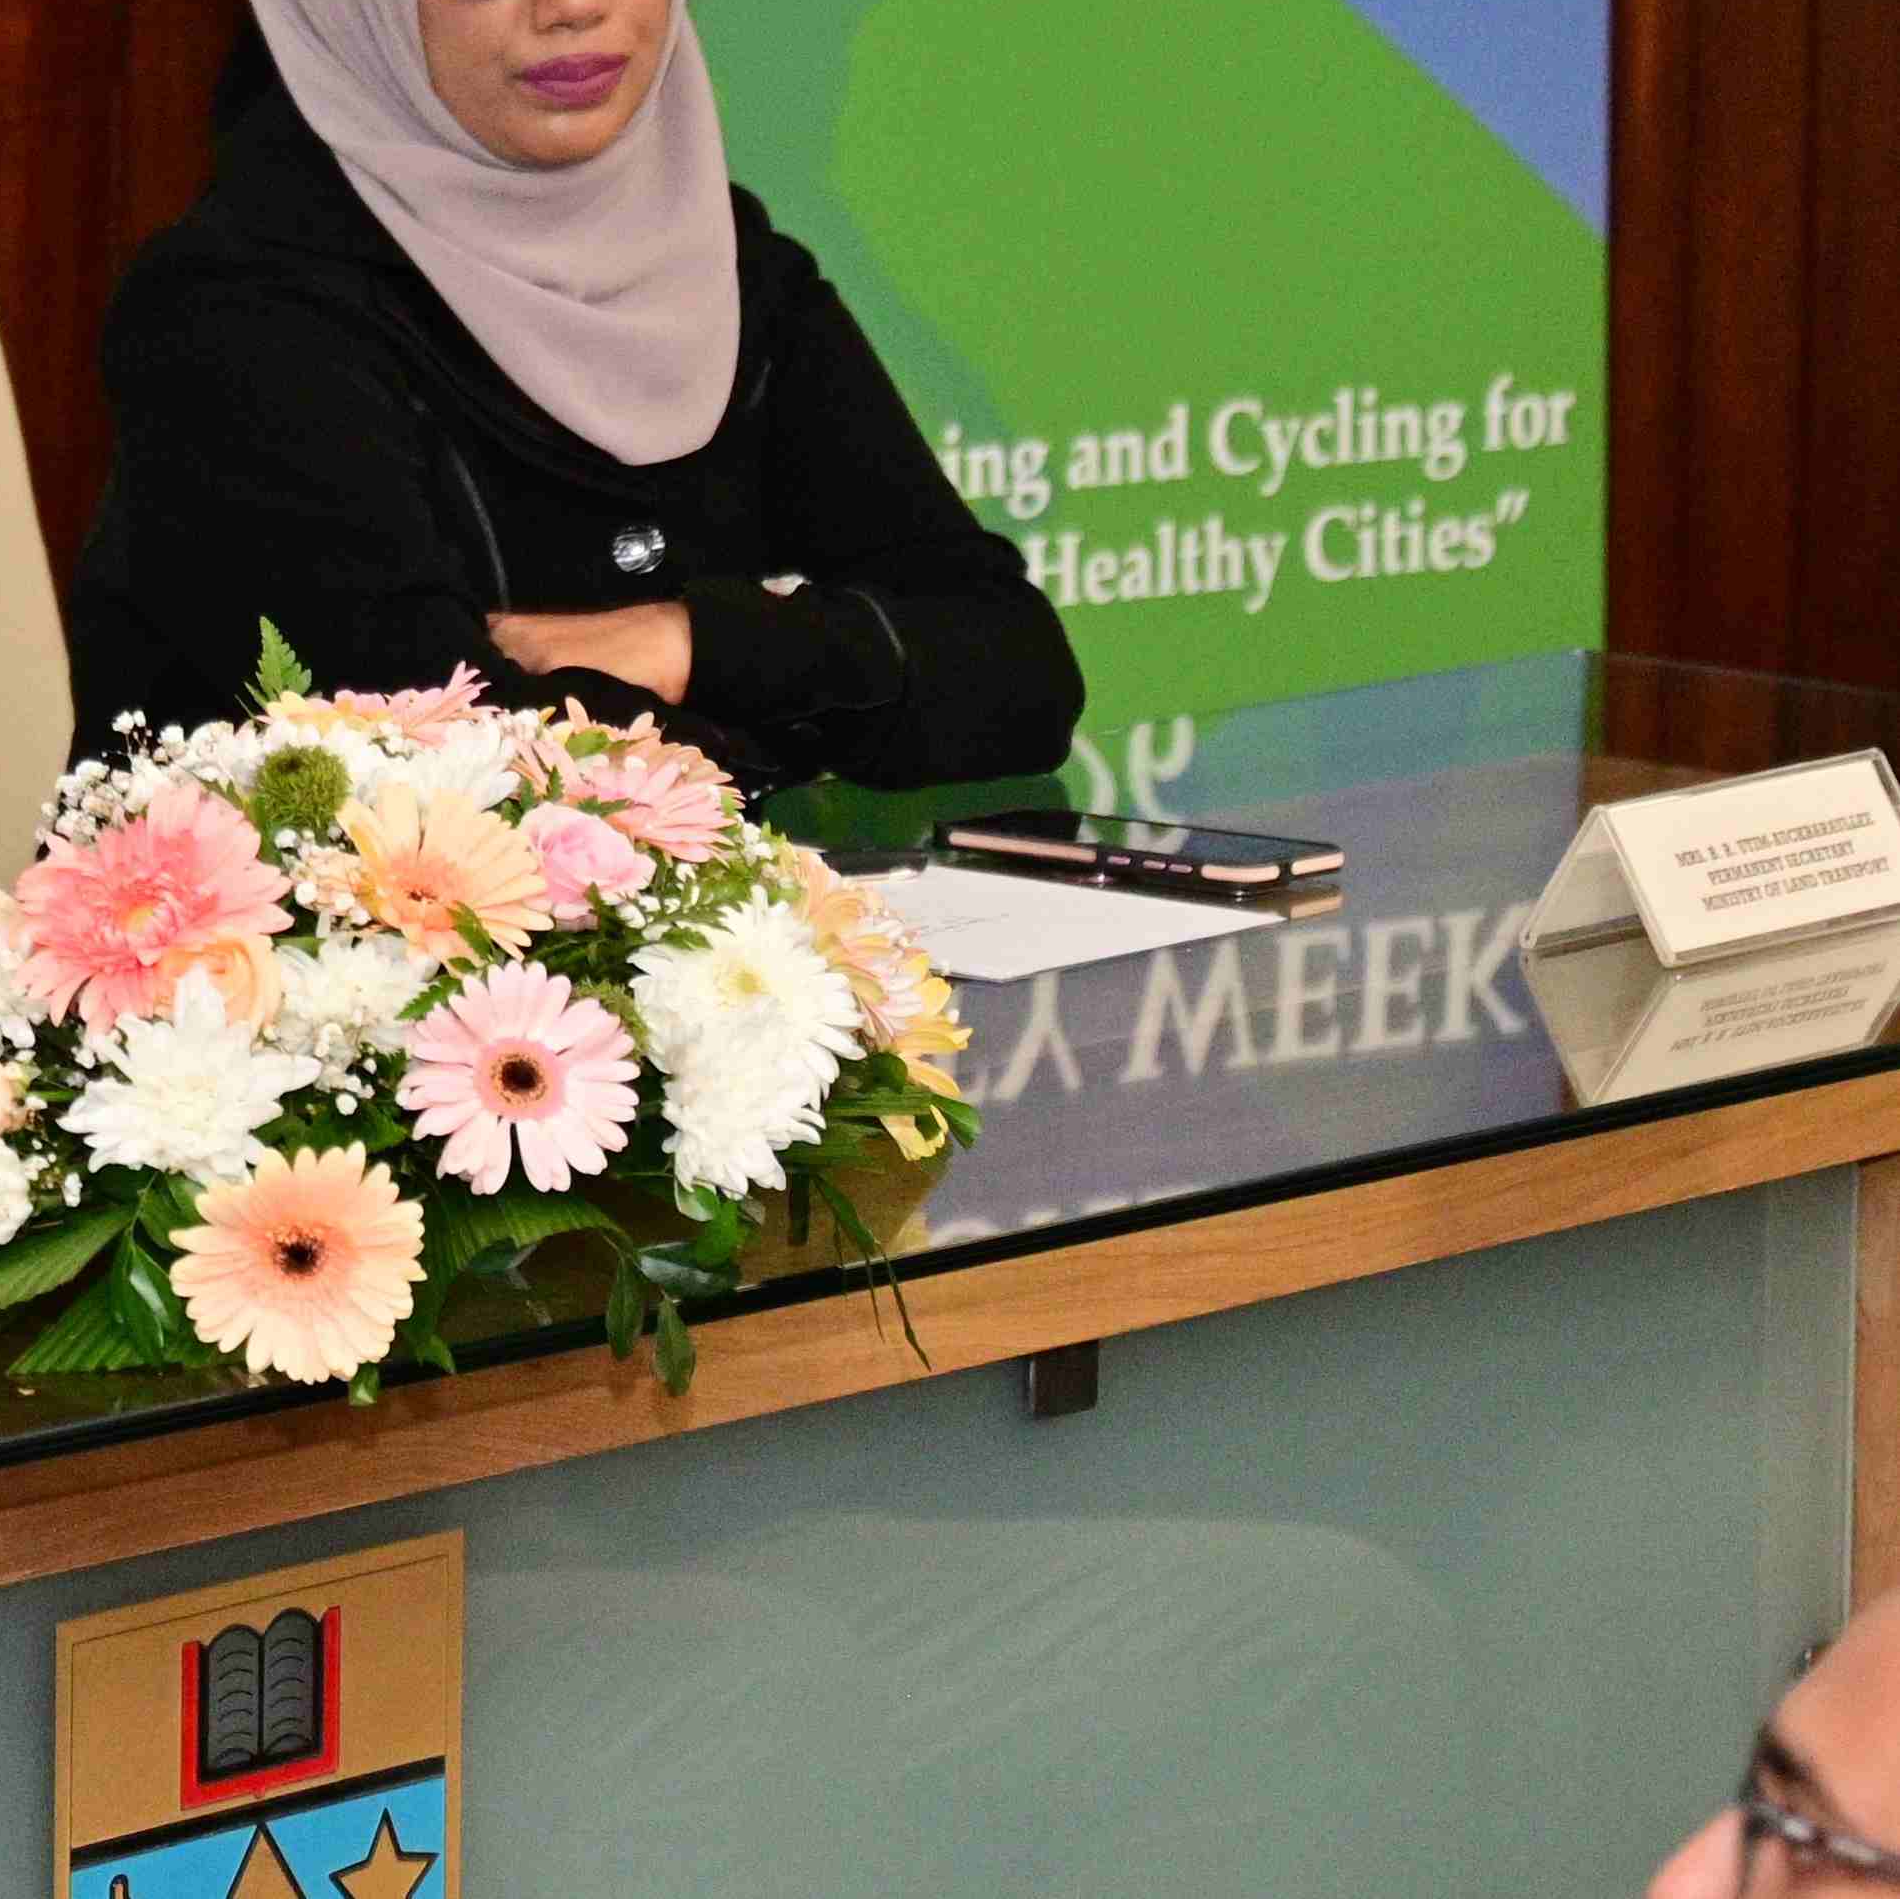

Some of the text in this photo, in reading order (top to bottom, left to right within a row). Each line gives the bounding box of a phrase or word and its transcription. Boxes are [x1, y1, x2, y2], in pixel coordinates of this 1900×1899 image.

[1067, 403, 1190, 489] and
[1209, 386, 1467, 496] Cycling
[1485, 372, 1577, 452] for
[1024, 520, 1287, 614] Healthy
